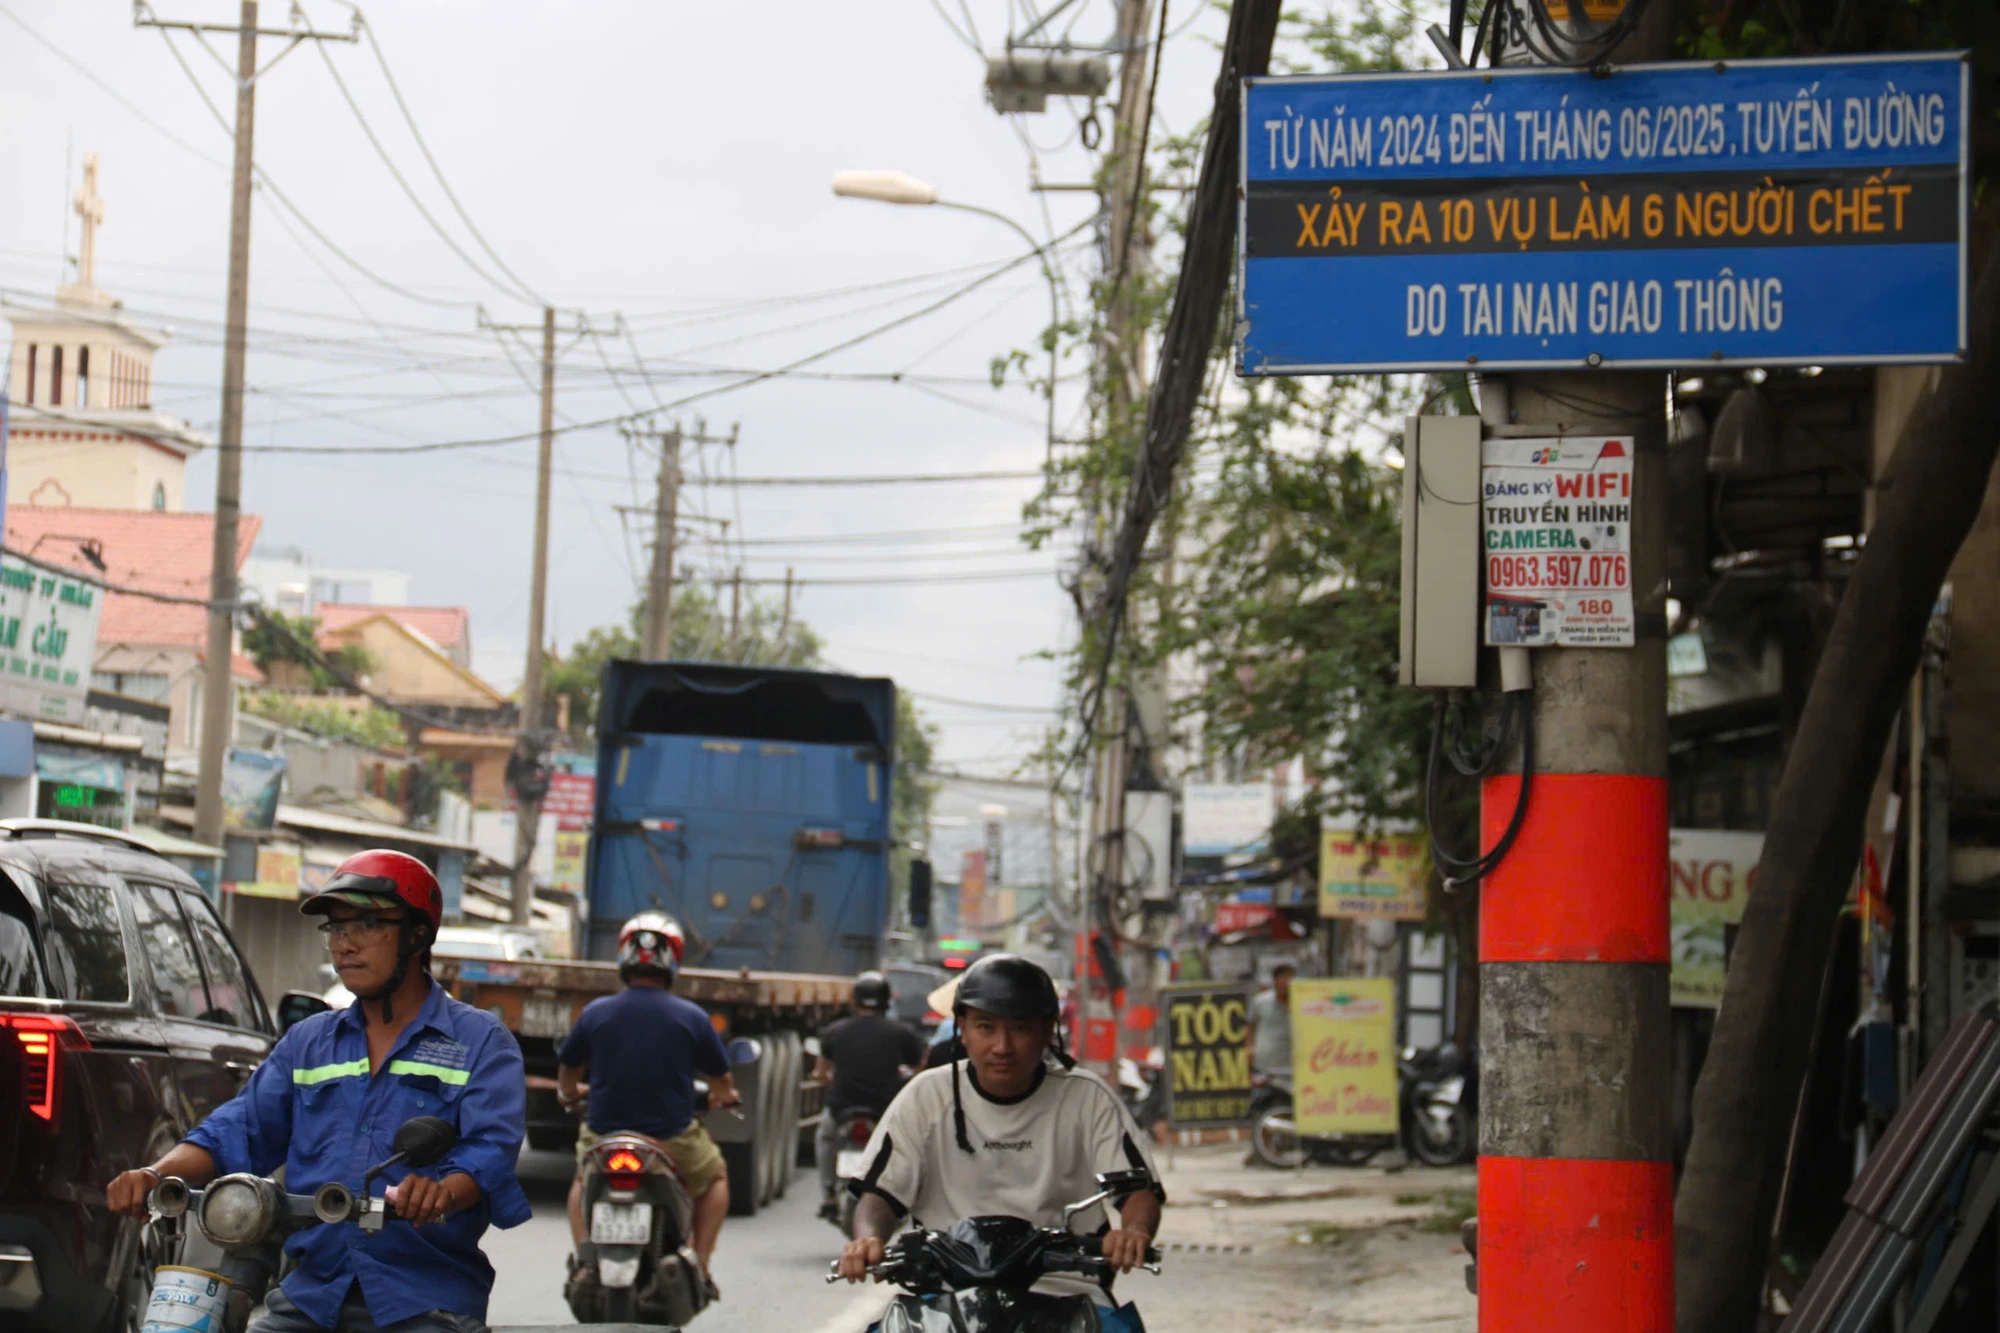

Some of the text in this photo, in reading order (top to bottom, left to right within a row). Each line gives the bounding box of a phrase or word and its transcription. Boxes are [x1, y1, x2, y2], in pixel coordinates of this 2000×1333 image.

[1264, 104, 1304, 170] TỪ
[1309, 104, 1372, 169] NĂM
[1378, 114, 1442, 166] 2024
[1448, 92, 1506, 164] ĐẾN
[1514, 93, 1612, 161] THÁNG
[1843, 80, 1946, 149] ĐƯỜNG
[1295, 166, 1912, 250] XẢY RA 10 VỤ LÀM 6 NGƯỜI CHẾT
[1406, 266, 1783, 348] DO TAI NẠN GIAO THÔNG
[1485, 481, 1529, 496] ĐĂNG
[1555, 472, 1630, 499] WIFI
[1577, 501, 1629, 523] HÌNH
[1486, 528, 1577, 549] CAMERA
[1489, 555, 1627, 588] 0963.597.076
[1577, 599, 1614, 615] 180
[1171, 1048, 1251, 1093] NAM
